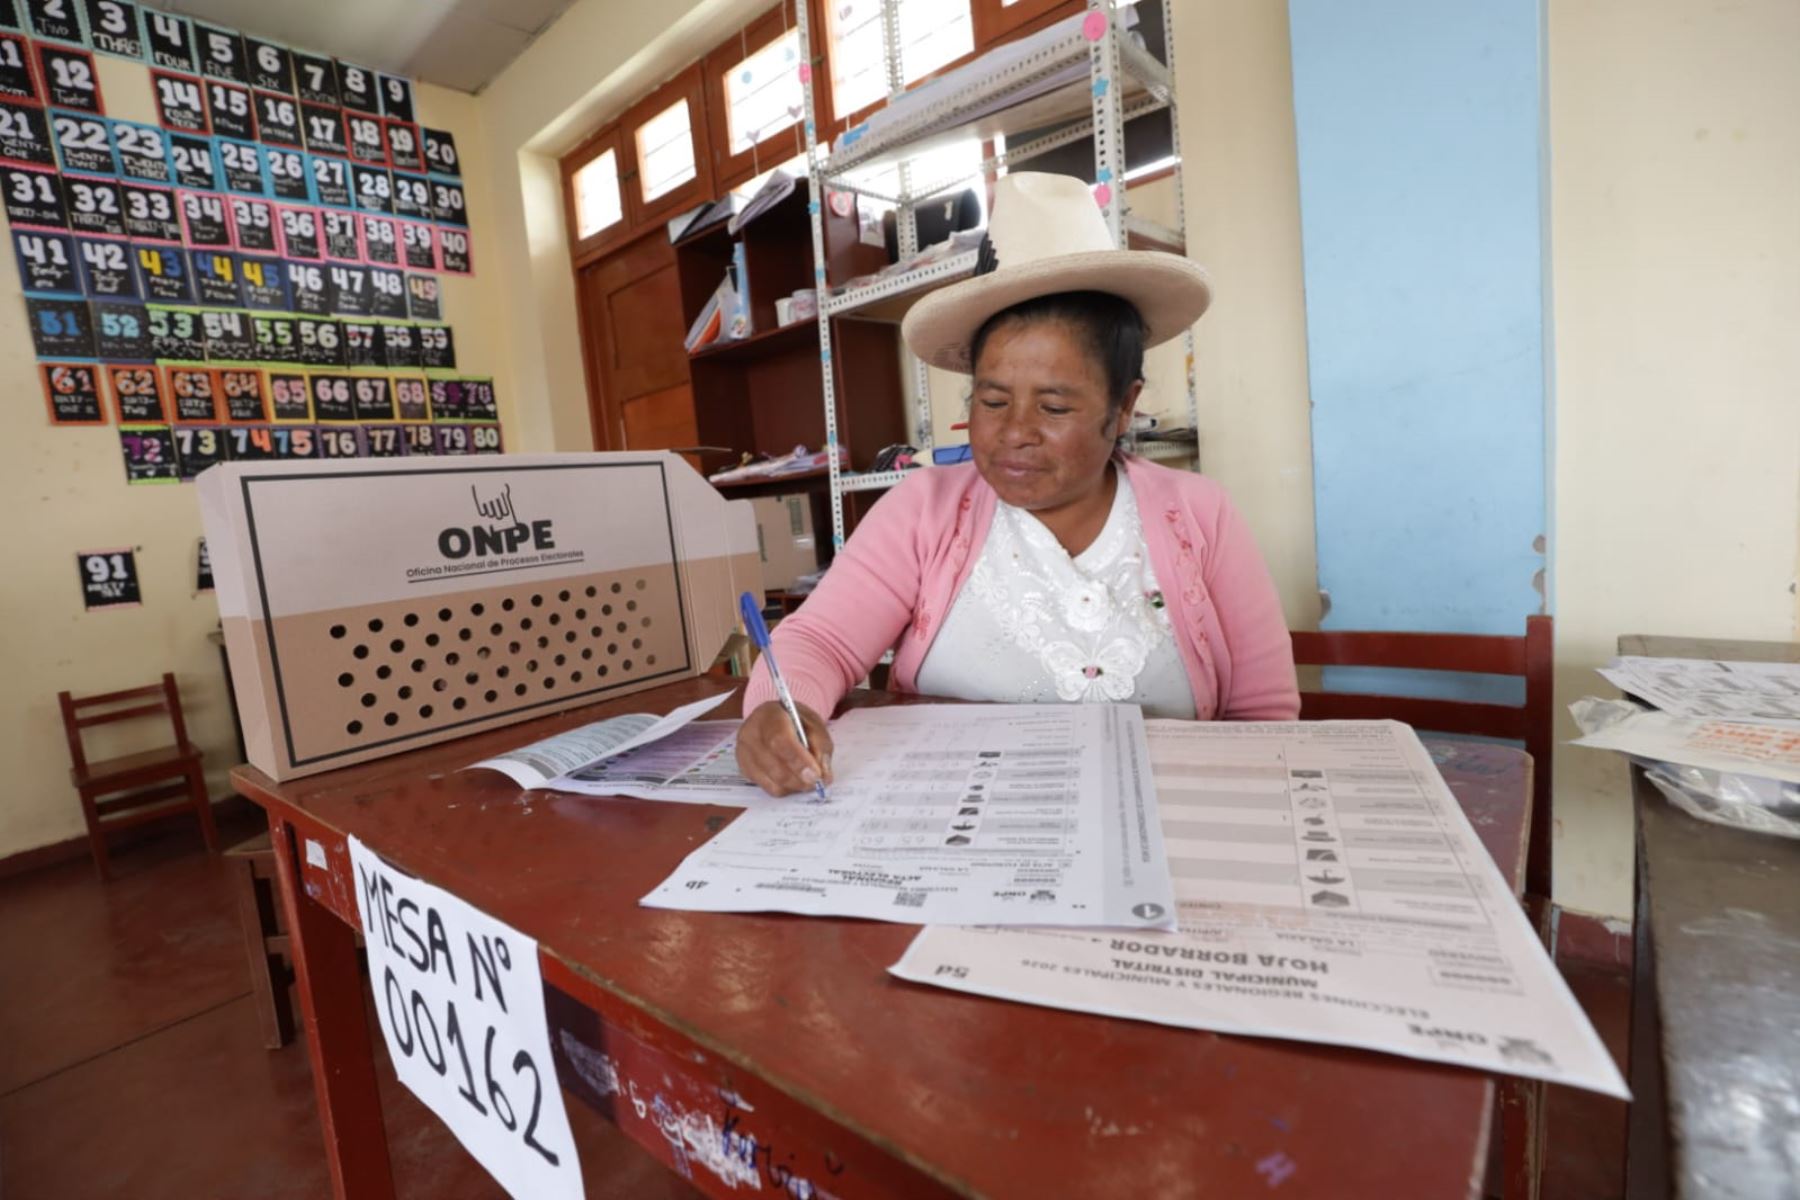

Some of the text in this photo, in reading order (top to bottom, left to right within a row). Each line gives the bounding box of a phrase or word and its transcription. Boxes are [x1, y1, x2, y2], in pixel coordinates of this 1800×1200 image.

[44, 0, 67, 19] 2
[98, 1, 127, 33] 3
[153, 16, 182, 46] 4
[0, 39, 22, 68] 1
[155, 51, 191, 70] FOUR
[208, 34, 234, 63] 5
[257, 45, 280, 73] 6
[52, 57, 94, 90] 12
[304, 64, 324, 91] 7
[346, 67, 367, 93] 8
[157, 78, 202, 113] 14
[212, 85, 248, 116] 15
[387, 79, 404, 103] 9
[0, 107, 34, 139] 21
[264, 99, 295, 127] 16
[54, 117, 112, 152] 22
[113, 124, 165, 159] 23
[310, 116, 336, 142] 17
[351, 118, 380, 146] 18
[389, 128, 413, 153] 19
[3, 146, 28, 159] ONE
[171, 145, 213, 175] 24
[221, 142, 259, 174] 25
[267, 150, 303, 179] 26
[427, 139, 456, 165] 20
[313, 158, 343, 185] 27
[359, 172, 390, 198] 28
[10, 173, 56, 203] 31
[72, 184, 120, 214] 32
[397, 180, 428, 205] 29
[435, 186, 463, 210] 30
[128, 191, 171, 220] 33
[184, 193, 223, 224] 34
[232, 199, 270, 228] 35
[281, 210, 314, 238] 36
[324, 211, 354, 237] 37
[365, 218, 394, 244] 38
[403, 223, 431, 250] 39
[18, 234, 69, 266] 41
[440, 230, 467, 254] 40
[82, 242, 128, 270] 42
[139, 249, 181, 277] 43
[195, 252, 234, 282] 44
[242, 260, 279, 288] 45
[288, 263, 323, 291] 46
[331, 266, 364, 293] 47
[371, 270, 403, 296] 48
[410, 276, 438, 302] 49
[37, 310, 81, 337] 51
[101, 312, 141, 338] 52
[148, 311, 194, 339] 53
[202, 312, 242, 338] 54
[254, 318, 294, 345] 55
[299, 320, 339, 349] 56
[346, 324, 375, 349] 57
[384, 325, 412, 348] 58
[420, 327, 448, 349] 59
[52, 366, 93, 394] 61
[115, 370, 155, 396] 62
[174, 372, 212, 398] 63
[223, 372, 259, 398] 64
[272, 379, 306, 403] 65
[316, 379, 349, 402] 66
[356, 379, 386, 402] 67
[397, 380, 425, 403] 68
[124, 436, 164, 463] 72
[176, 430, 217, 455] 73
[231, 428, 272, 454] 74
[273, 429, 314, 456] 75
[322, 431, 357, 455] 76
[369, 429, 396, 451] 77
[405, 426, 433, 447] 78
[441, 428, 467, 449] 79
[473, 427, 499, 448] 80
[438, 519, 555, 559] ONPE
[86, 555, 128, 583] 91
[406, 550, 585, 578] Oficina Nacional de Procesos Electorales
[685, 879, 710, 891] 4b
[359, 861, 457, 986] MESA
[1110, 939, 1329, 974] HOJA BORRADOR
[933, 964, 971, 980] 5d
[1062, 965, 1171, 987] MUNICIPALES
[1111, 959, 1317, 989] MUNICIPAL DISTRITAL
[1175, 980, 1185, 988] Y
[1192, 981, 1303, 999] REGIONALES
[1309, 992, 1430, 1021] ELECCIONES
[1406, 1023, 1489, 1047] ONPE
[385, 965, 561, 1167] 00162
